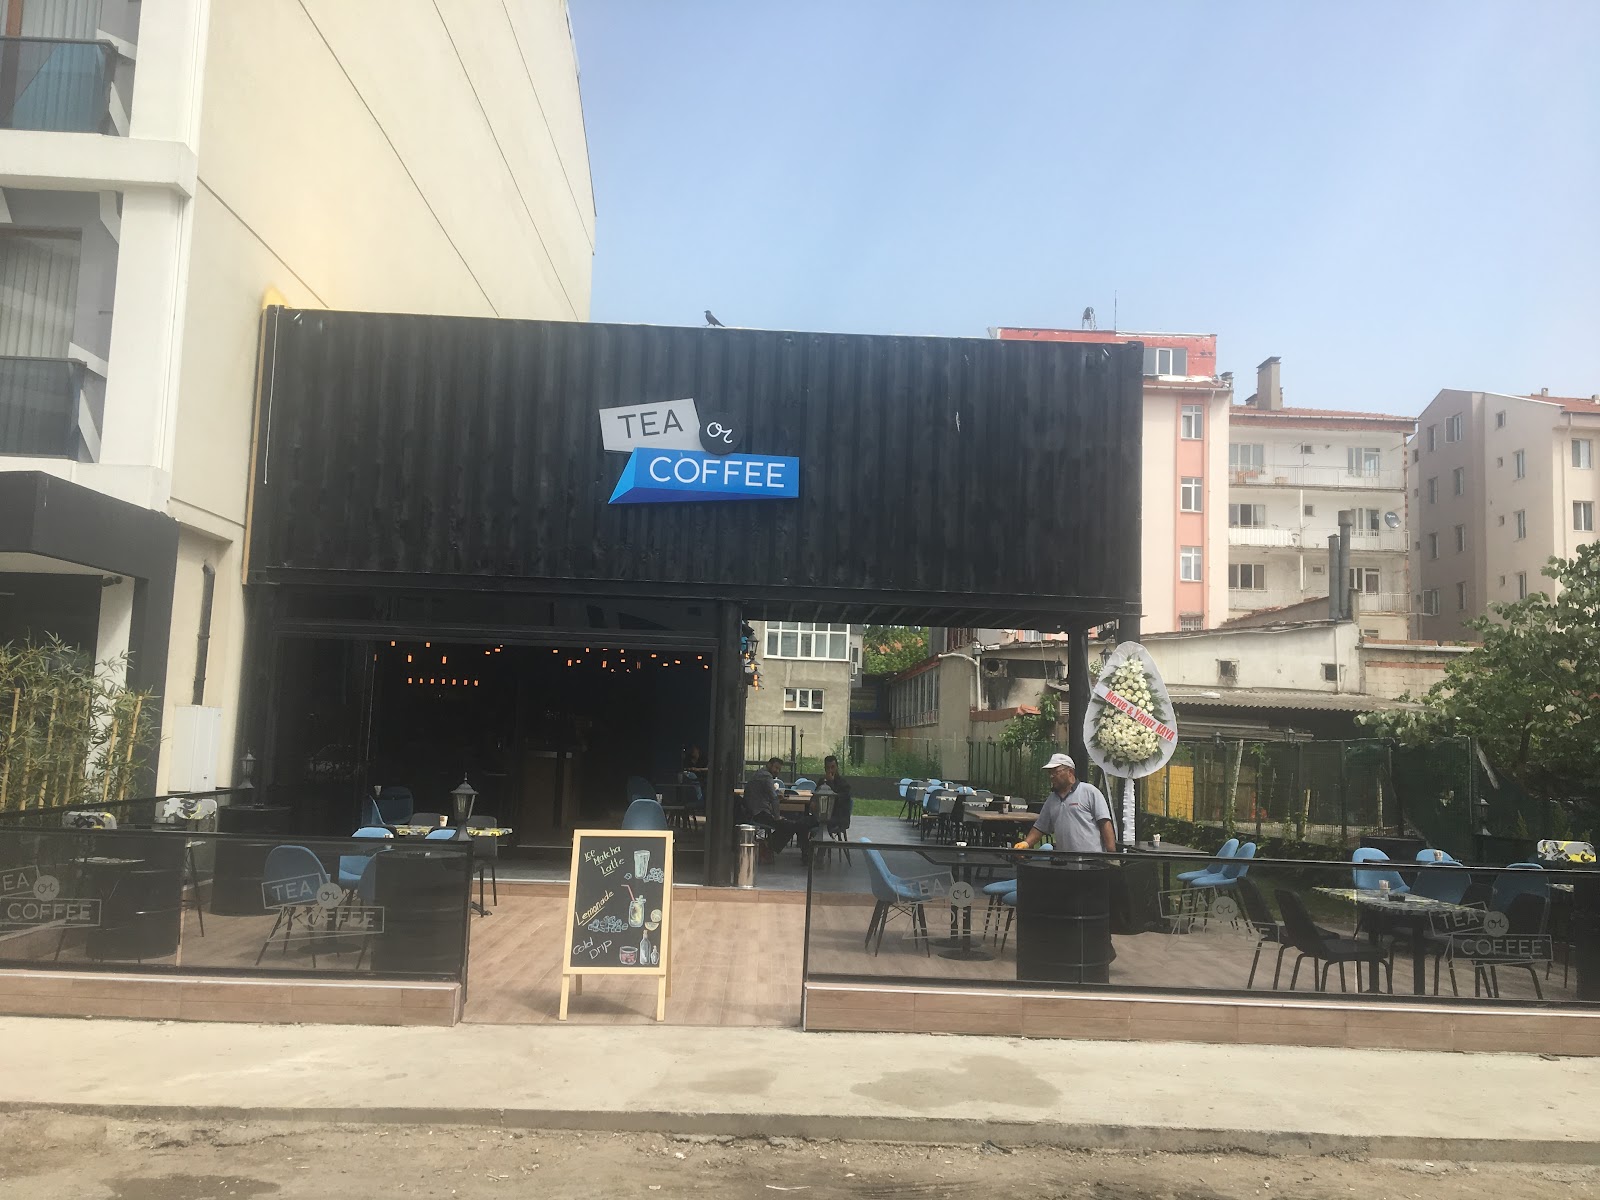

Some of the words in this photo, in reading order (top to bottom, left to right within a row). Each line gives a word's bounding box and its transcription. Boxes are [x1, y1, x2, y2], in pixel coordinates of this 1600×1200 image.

[617, 409, 684, 439] TEA
[706, 421, 733, 444] or
[649, 456, 786, 488] COFFEE
[1104, 690, 1128, 715] Merve
[1126, 706, 1133, 716] &
[1133, 709, 1157, 729] Yavuz
[1155, 723, 1176, 742] KAYA
[600, 857, 625, 875] Latte
[2, 872, 30, 891] EA
[271, 880, 313, 901] TEA
[907, 878, 945, 898] TEA
[7, 902, 92, 920] COFFEE
[575, 889, 614, 926] Lemonade
[1167, 892, 1208, 911] TEA
[1439, 910, 1479, 929] TEA
[573, 936, 593, 955] Cold
[1461, 938, 1543, 955] COFFEE
